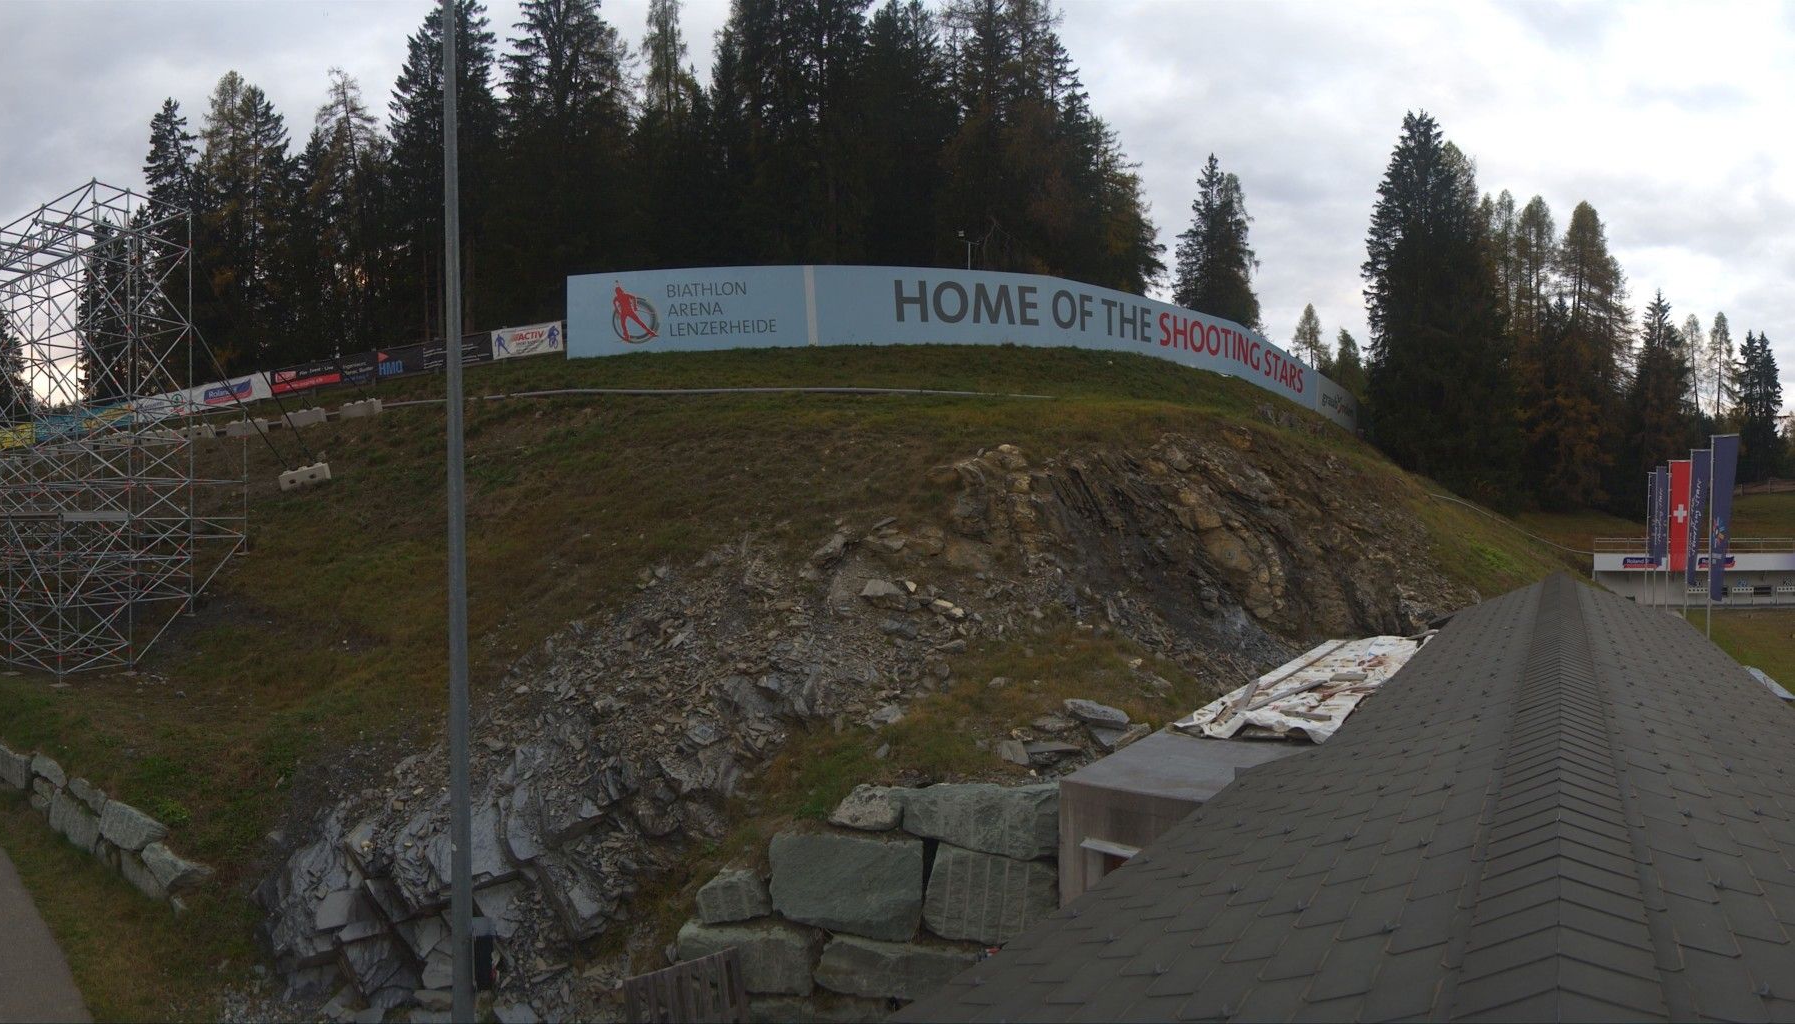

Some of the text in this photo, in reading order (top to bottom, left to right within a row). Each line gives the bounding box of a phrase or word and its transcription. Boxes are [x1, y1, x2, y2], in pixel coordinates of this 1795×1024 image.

[666, 281, 748, 299] BIATHLON
[667, 301, 723, 318] ARENA
[518, 330, 545, 341] ACTIV
[669, 317, 777, 338] LENZERHEIDE
[893, 278, 1304, 393] HOME OF THE SHOOTING STARS
